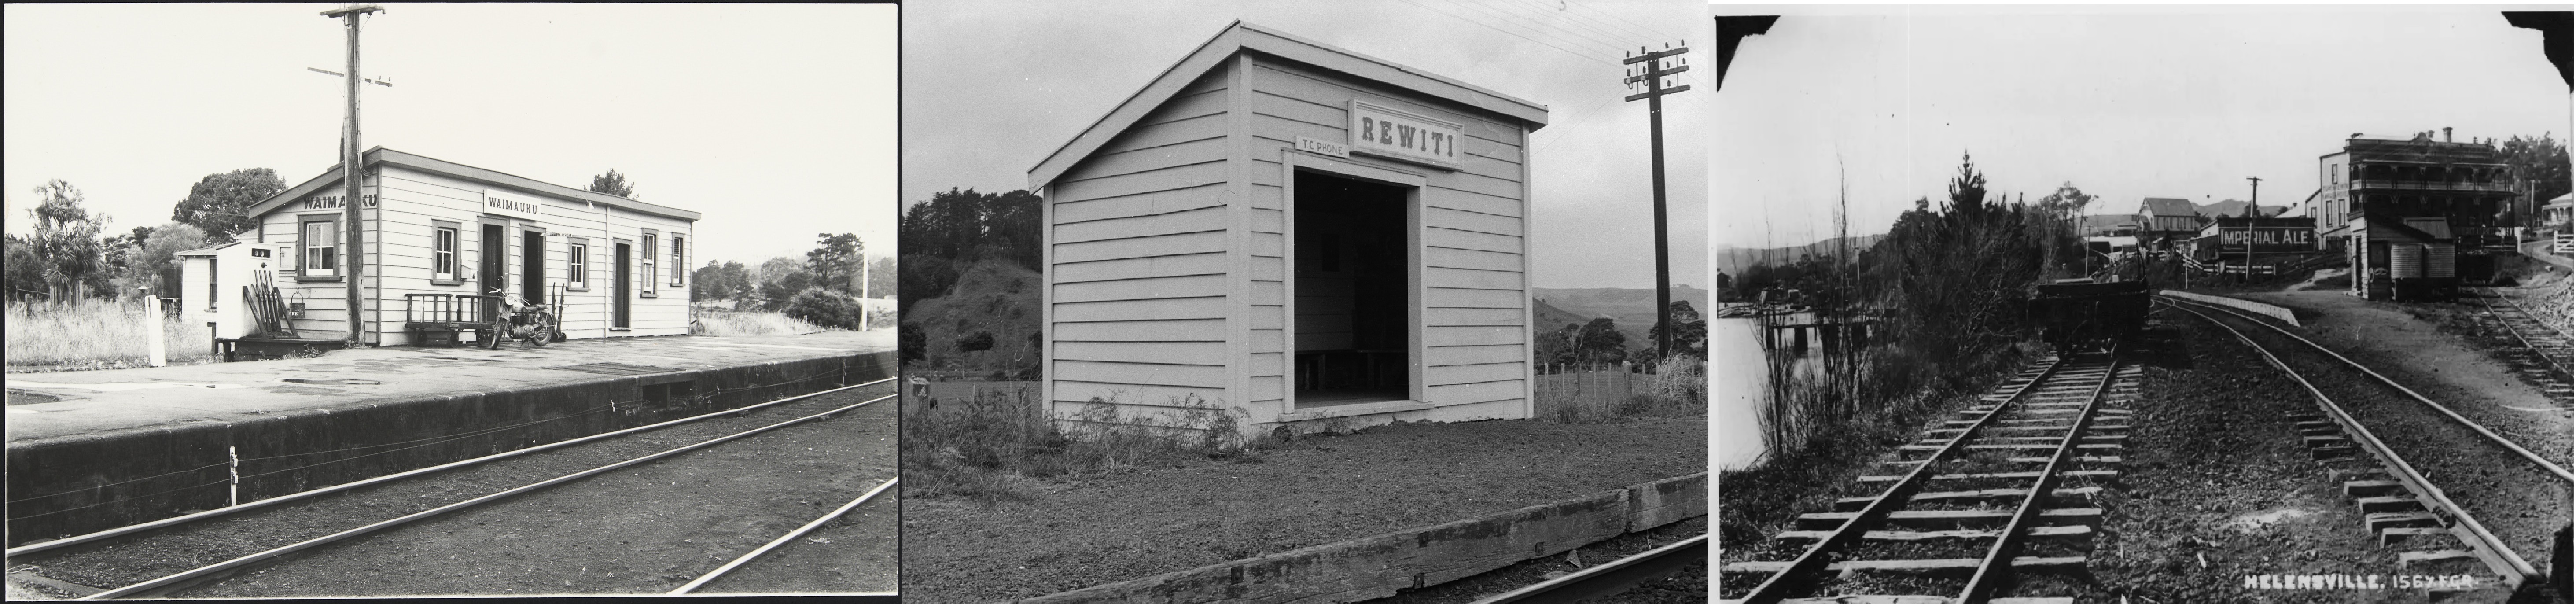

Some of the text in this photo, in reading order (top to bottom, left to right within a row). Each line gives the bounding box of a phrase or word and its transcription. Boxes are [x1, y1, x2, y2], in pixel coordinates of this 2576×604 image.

[1362, 117, 1453, 157] REWITI
[1317, 142, 1343, 155] PHONE
[304, 194, 377, 209] WAIMAKU
[489, 196, 537, 214] WAIMAUKU
[2220, 229, 2279, 245] IMPERIAL
